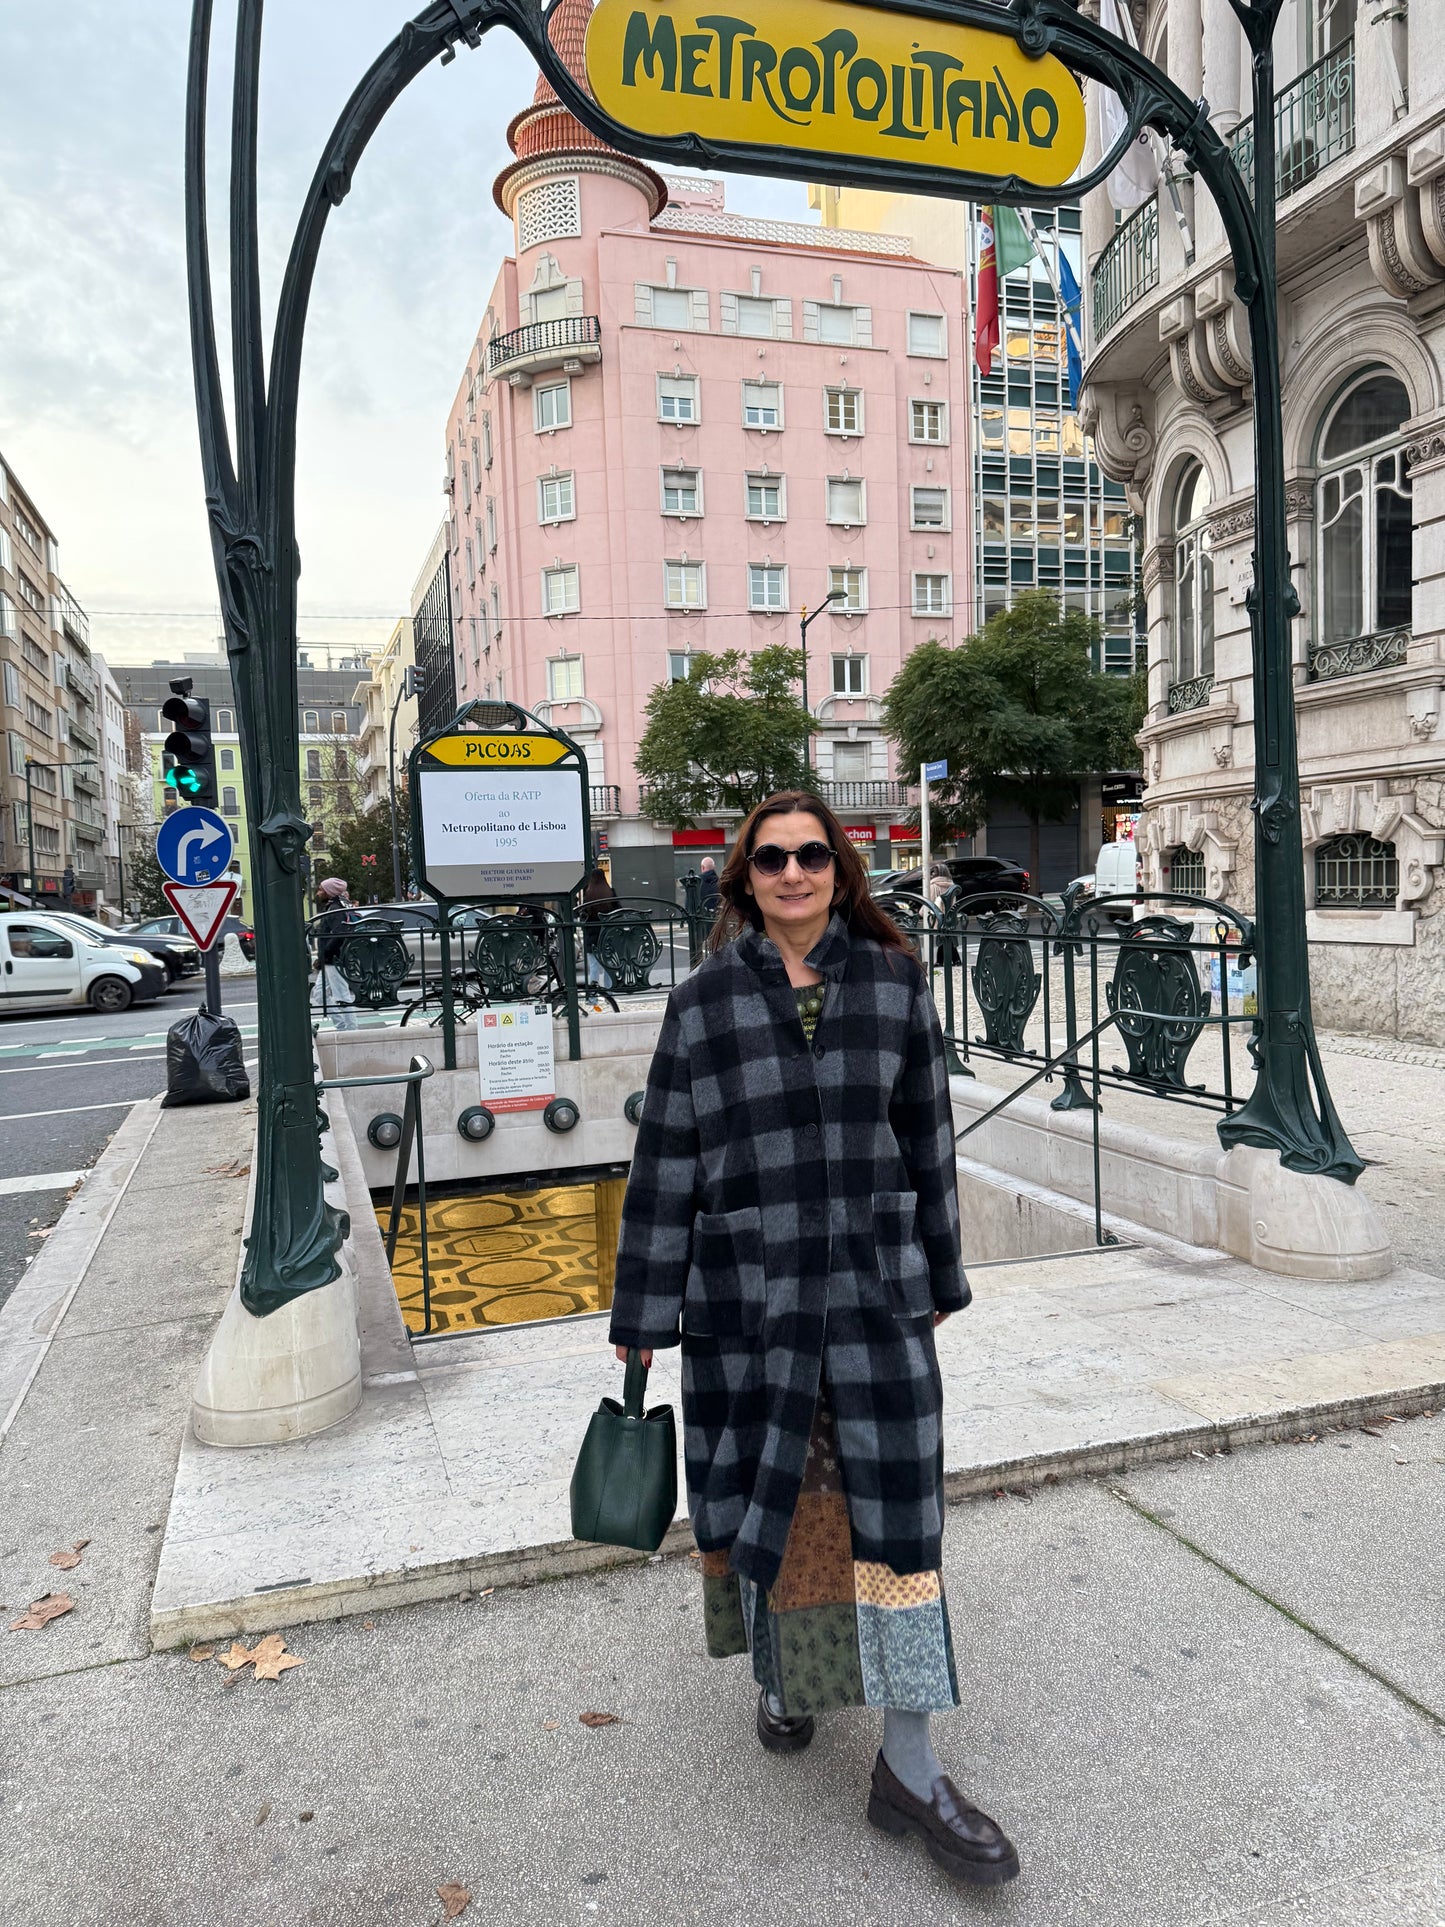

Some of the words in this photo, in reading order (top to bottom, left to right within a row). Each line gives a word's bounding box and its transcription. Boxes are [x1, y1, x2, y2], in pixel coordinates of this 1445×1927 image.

[621, 11, 1059, 149] METROPOLITANO
[465, 743, 531, 758] PICOAS
[464, 791, 496, 801] Oferta
[498, 791, 510, 801] da
[512, 791, 542, 801] RATP
[498, 810, 510, 818] ao
[442, 822, 516, 834] Metropolitano
[518, 822, 530, 831] de
[533, 821, 567, 831] Lisboa
[845, 829, 872, 839] chan
[495, 838, 518, 847] 1995
